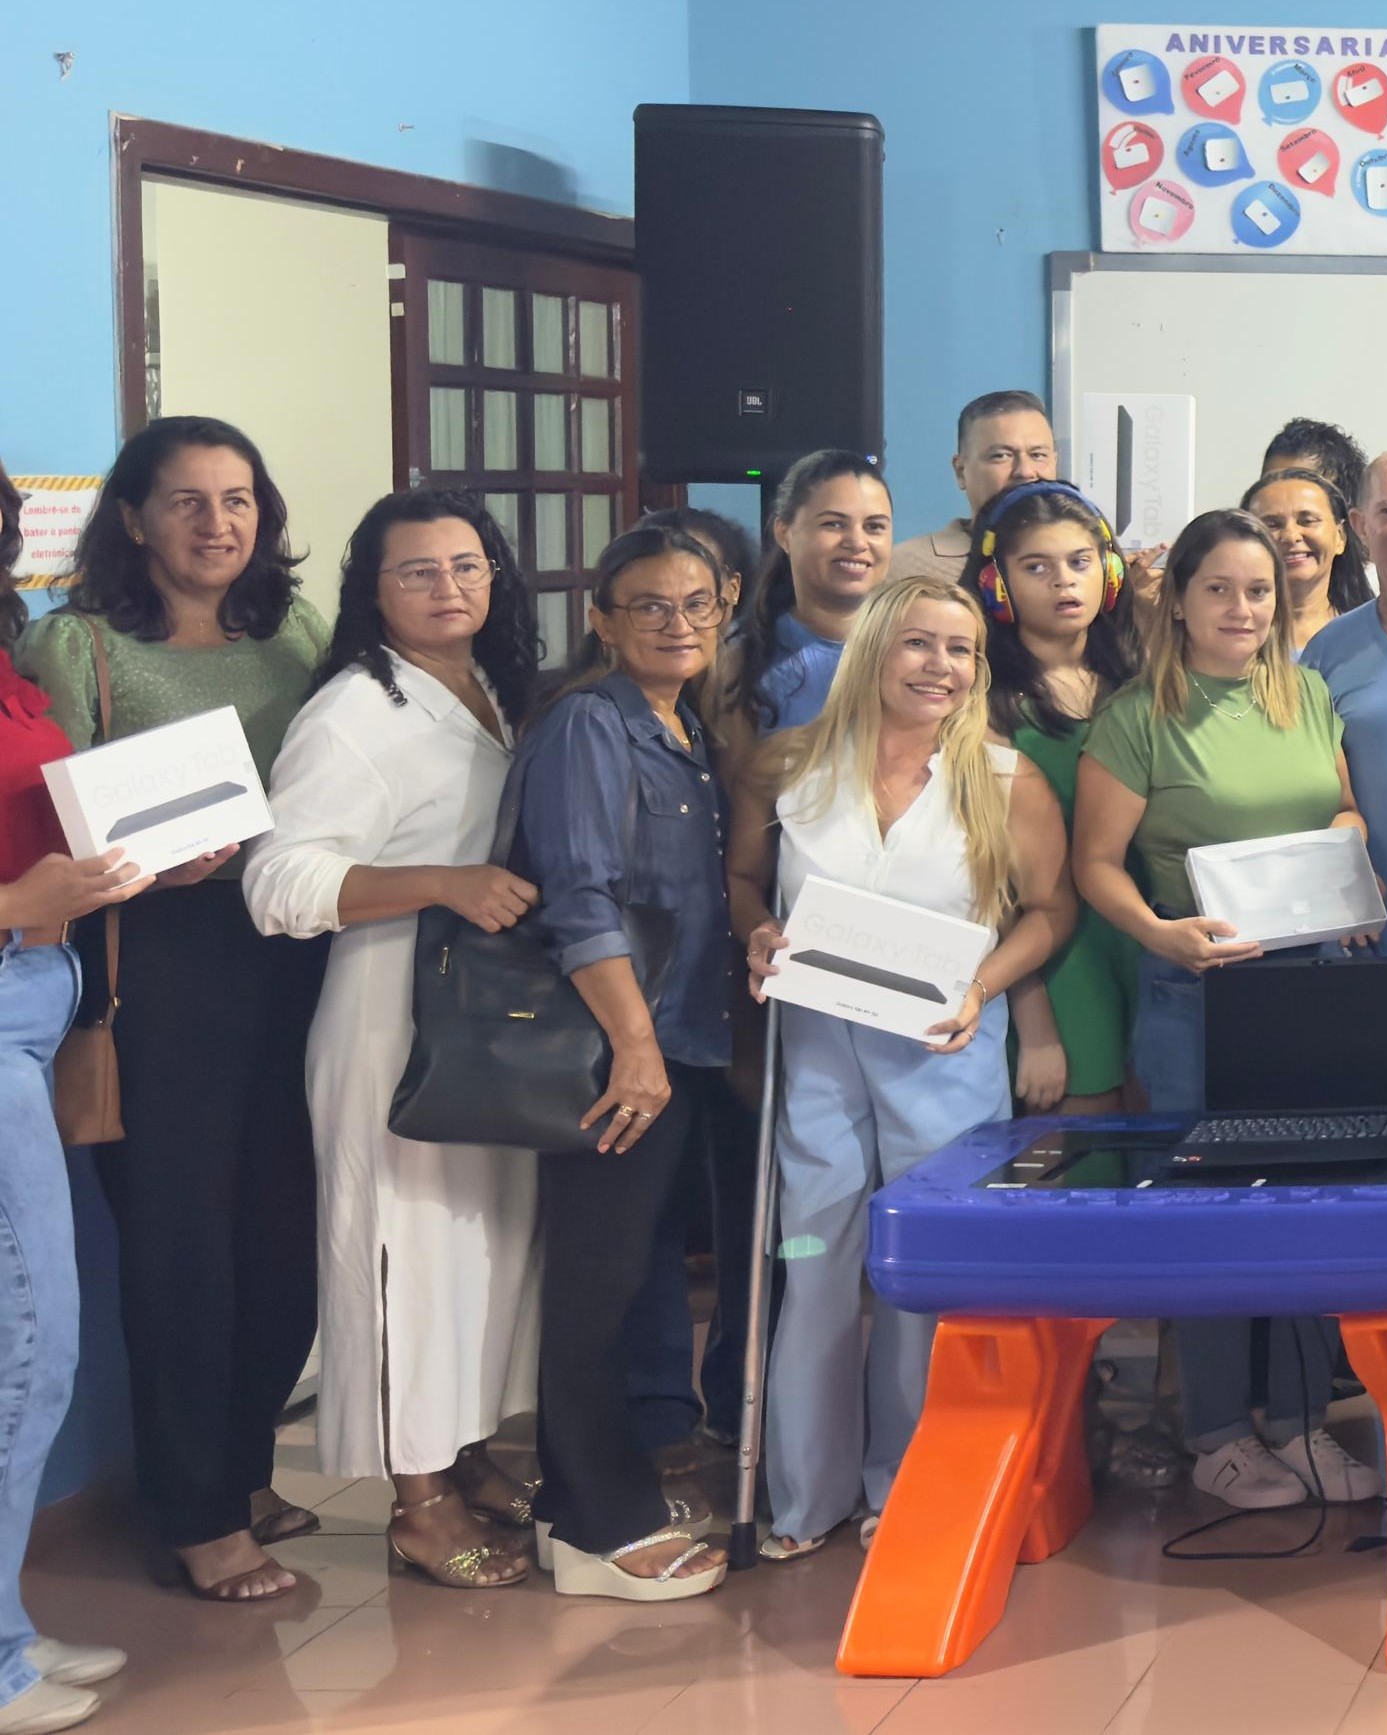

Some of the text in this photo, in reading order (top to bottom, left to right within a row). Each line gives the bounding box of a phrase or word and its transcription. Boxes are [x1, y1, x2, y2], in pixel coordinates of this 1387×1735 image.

[1137, 405, 1165, 538] Galaxy Tab
[802, 912, 961, 975] Galaxy Tab
